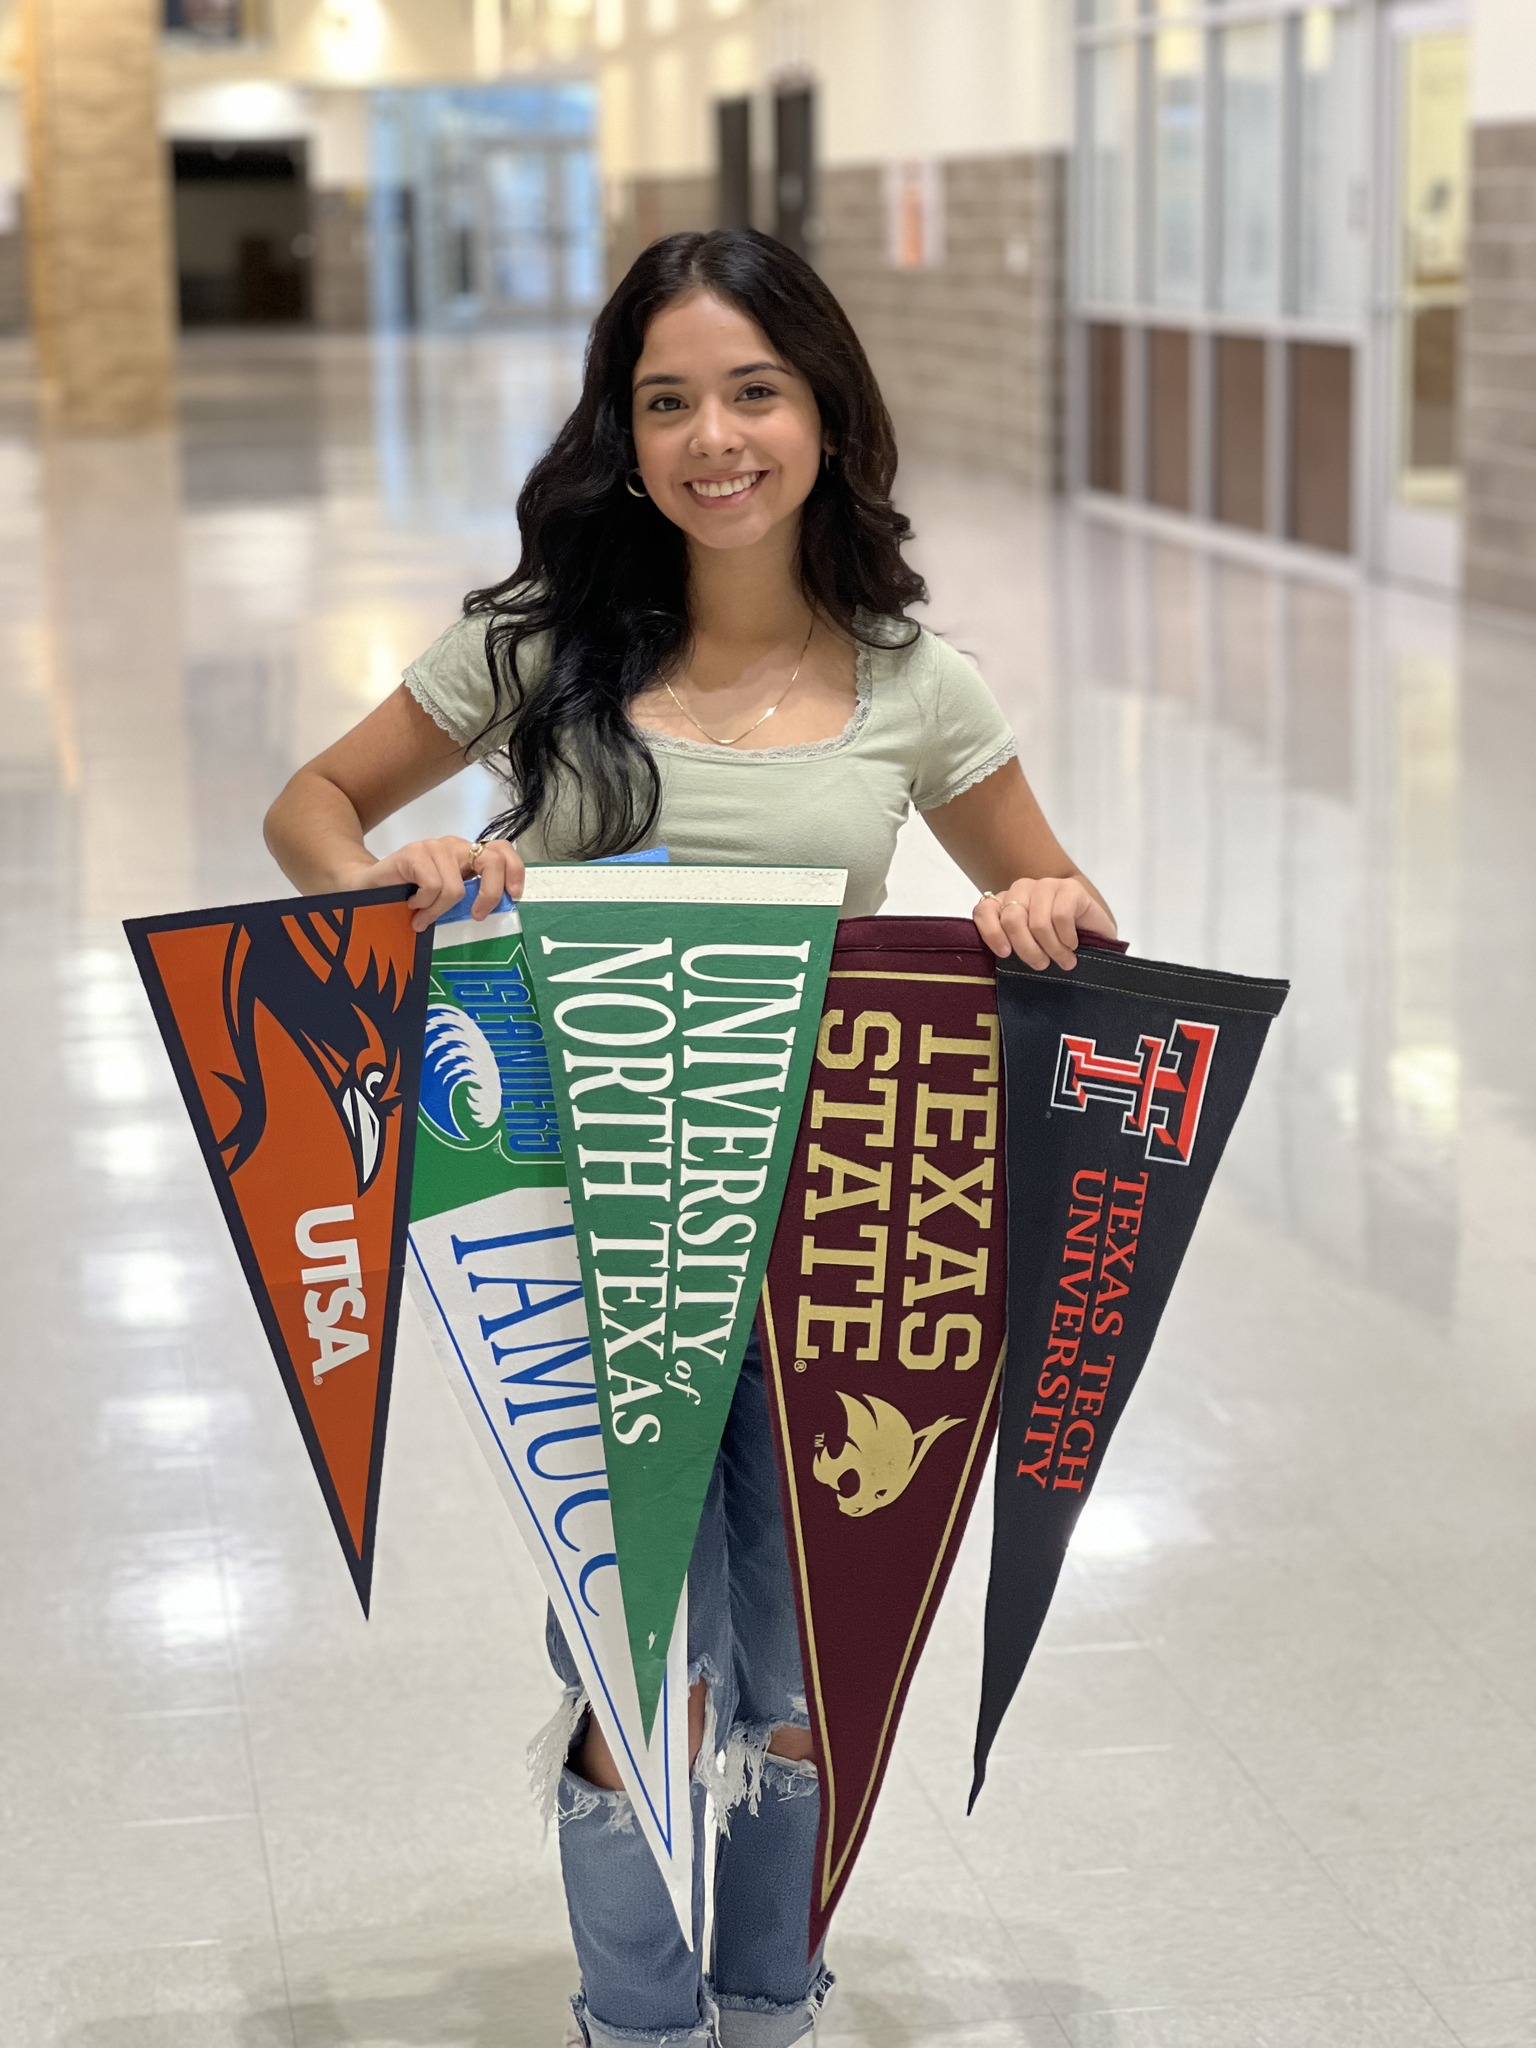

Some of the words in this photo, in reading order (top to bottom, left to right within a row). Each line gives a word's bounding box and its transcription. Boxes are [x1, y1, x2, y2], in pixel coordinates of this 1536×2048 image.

[439, 962, 562, 1154] ISLANDERS
[540, 936, 677, 1203] NORTH
[673, 940, 811, 1366] UNIVERSITY
[295, 1204, 370, 1378] UTSA
[796, 1009, 902, 1362] STATE
[899, 1010, 1000, 1371] TEXAS
[1091, 1170, 1149, 1337] TEXAS
[589, 1221, 673, 1445] TEXAS
[664, 1359, 701, 1405] of
[1016, 1168, 1108, 1488] UNIVERSITY
[1053, 1355, 1116, 1493] TECH
